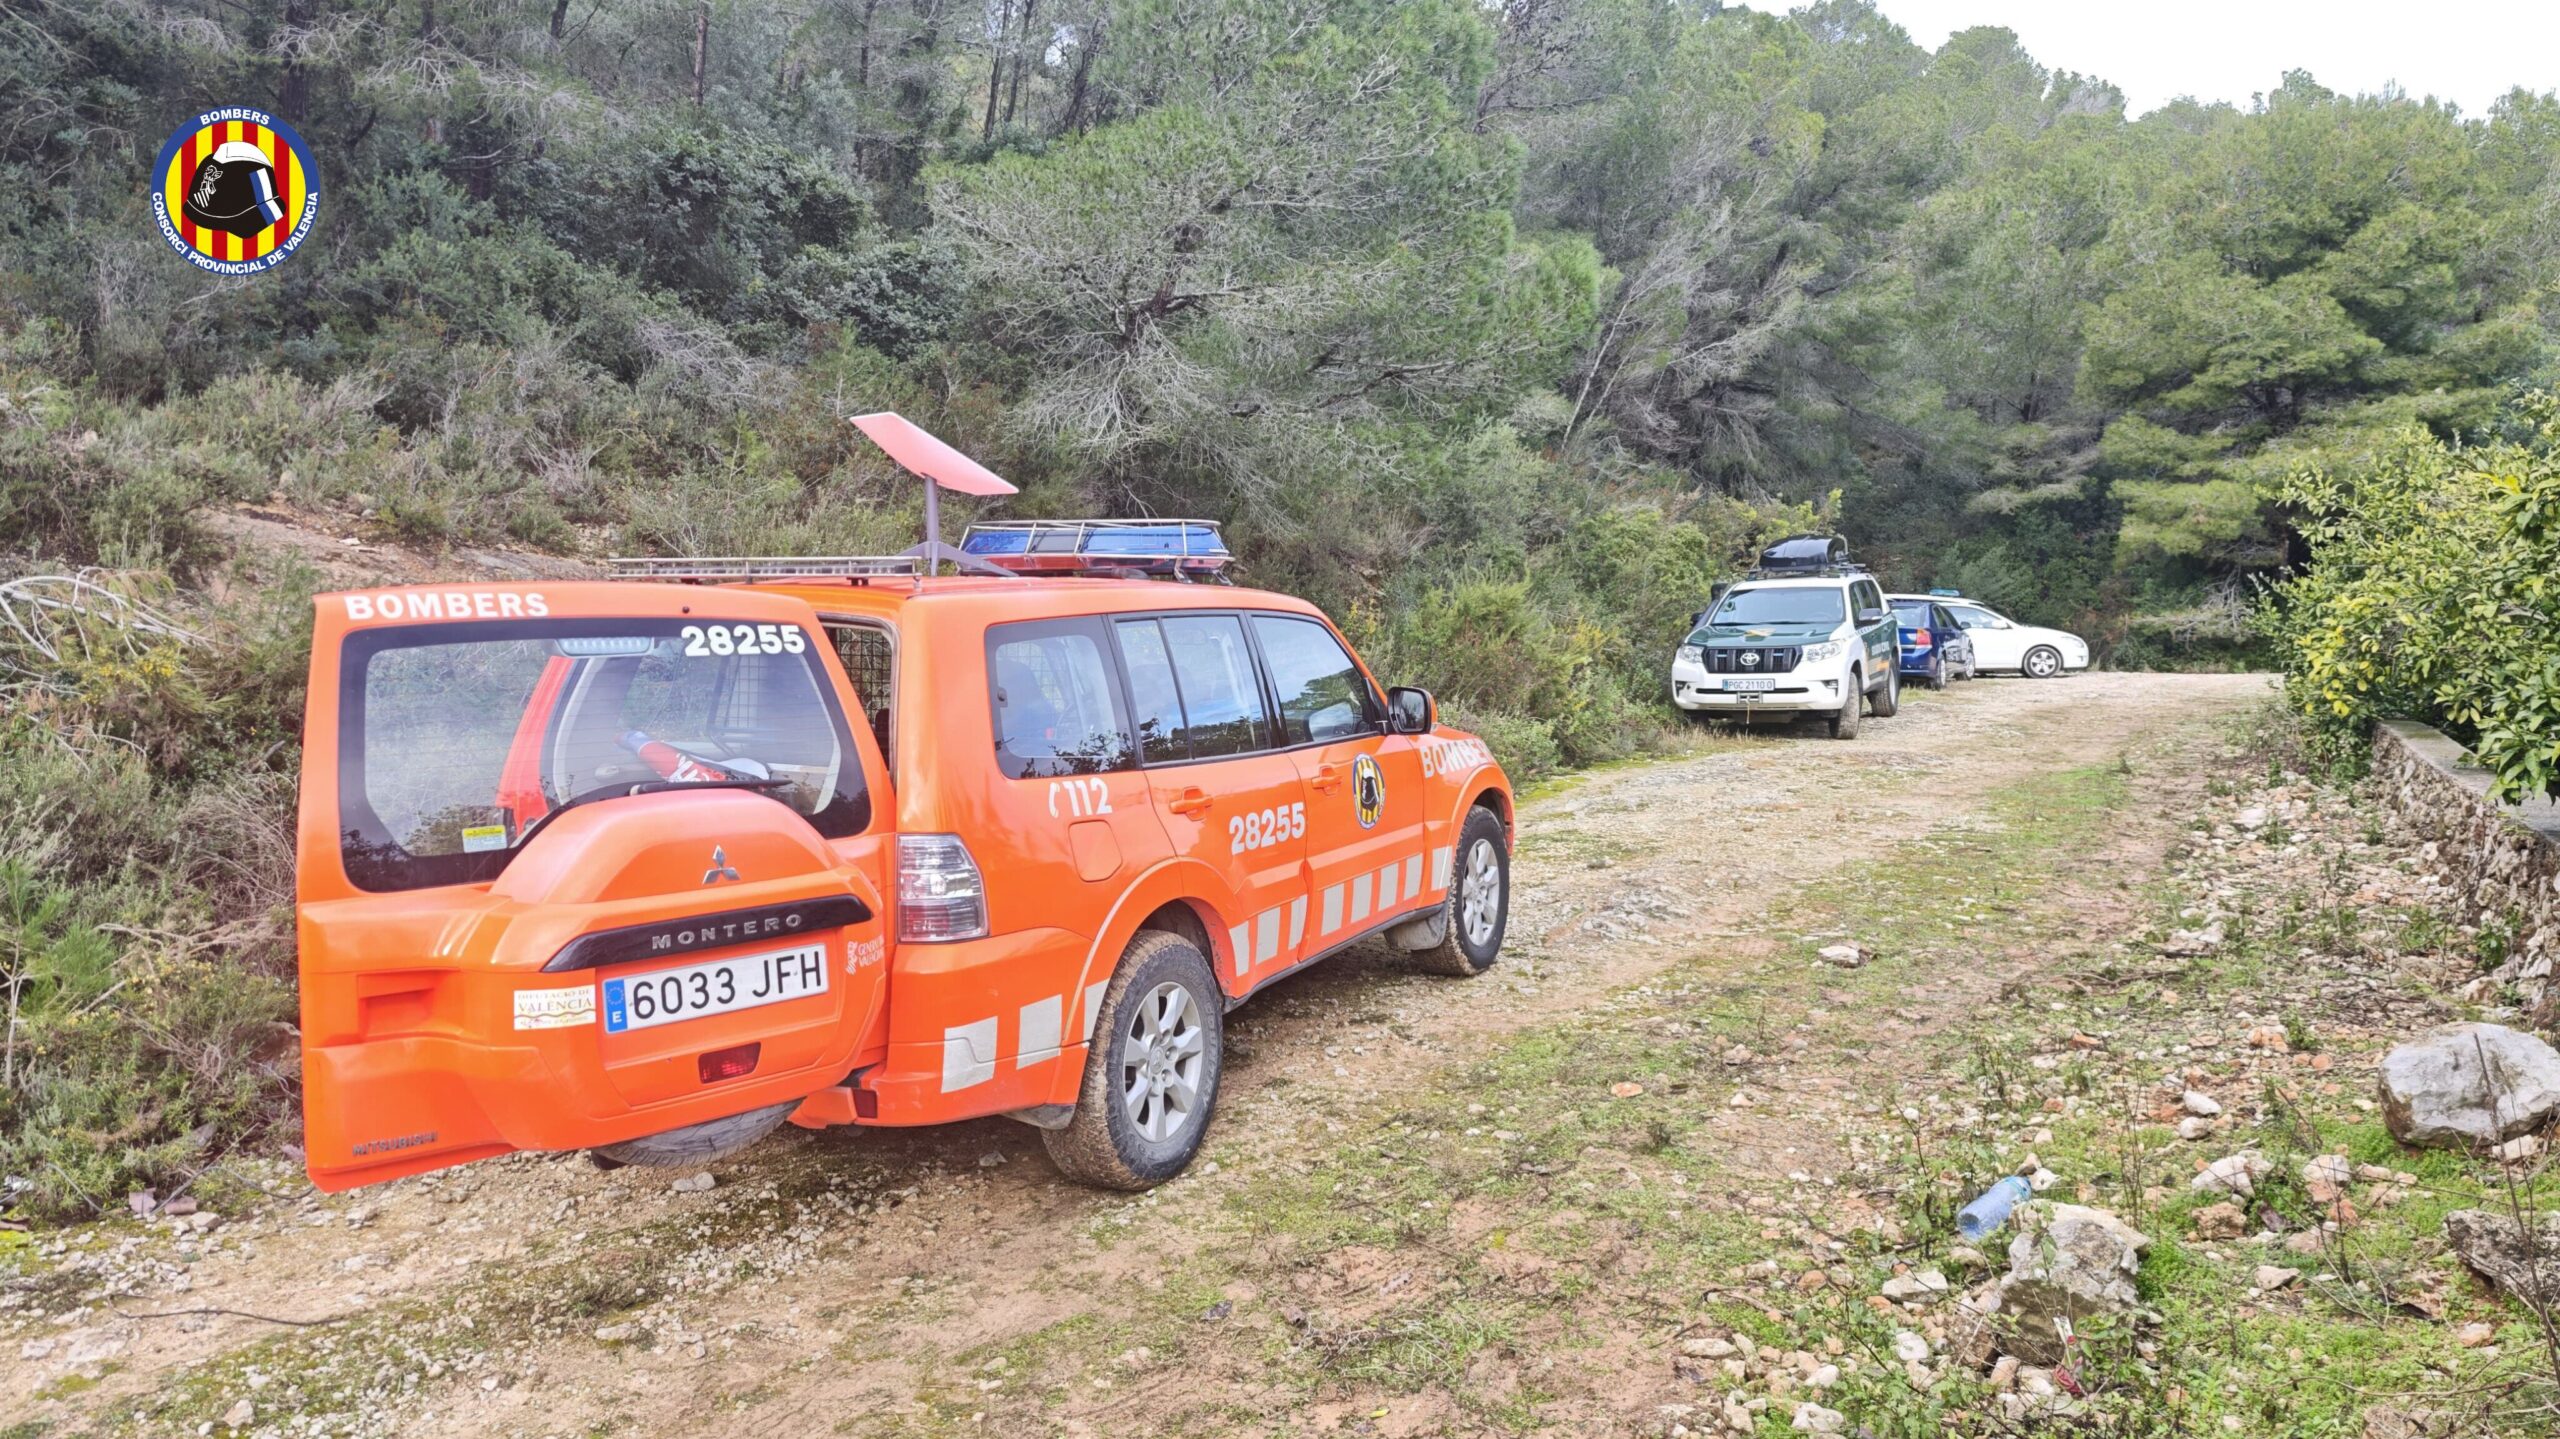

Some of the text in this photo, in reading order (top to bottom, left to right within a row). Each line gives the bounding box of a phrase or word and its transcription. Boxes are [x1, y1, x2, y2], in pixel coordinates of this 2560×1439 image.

[344, 593, 549, 620] BOMBERS
[681, 624, 806, 657] 28255
[1728, 681, 1743, 690] PGC
[1063, 777, 1113, 817] 112
[1229, 802, 1306, 856] 28255
[652, 914, 802, 950] MONTERO
[612, 951, 822, 1024] E 6033 JFH
[352, 1131, 438, 1155] MITSUBISHI
